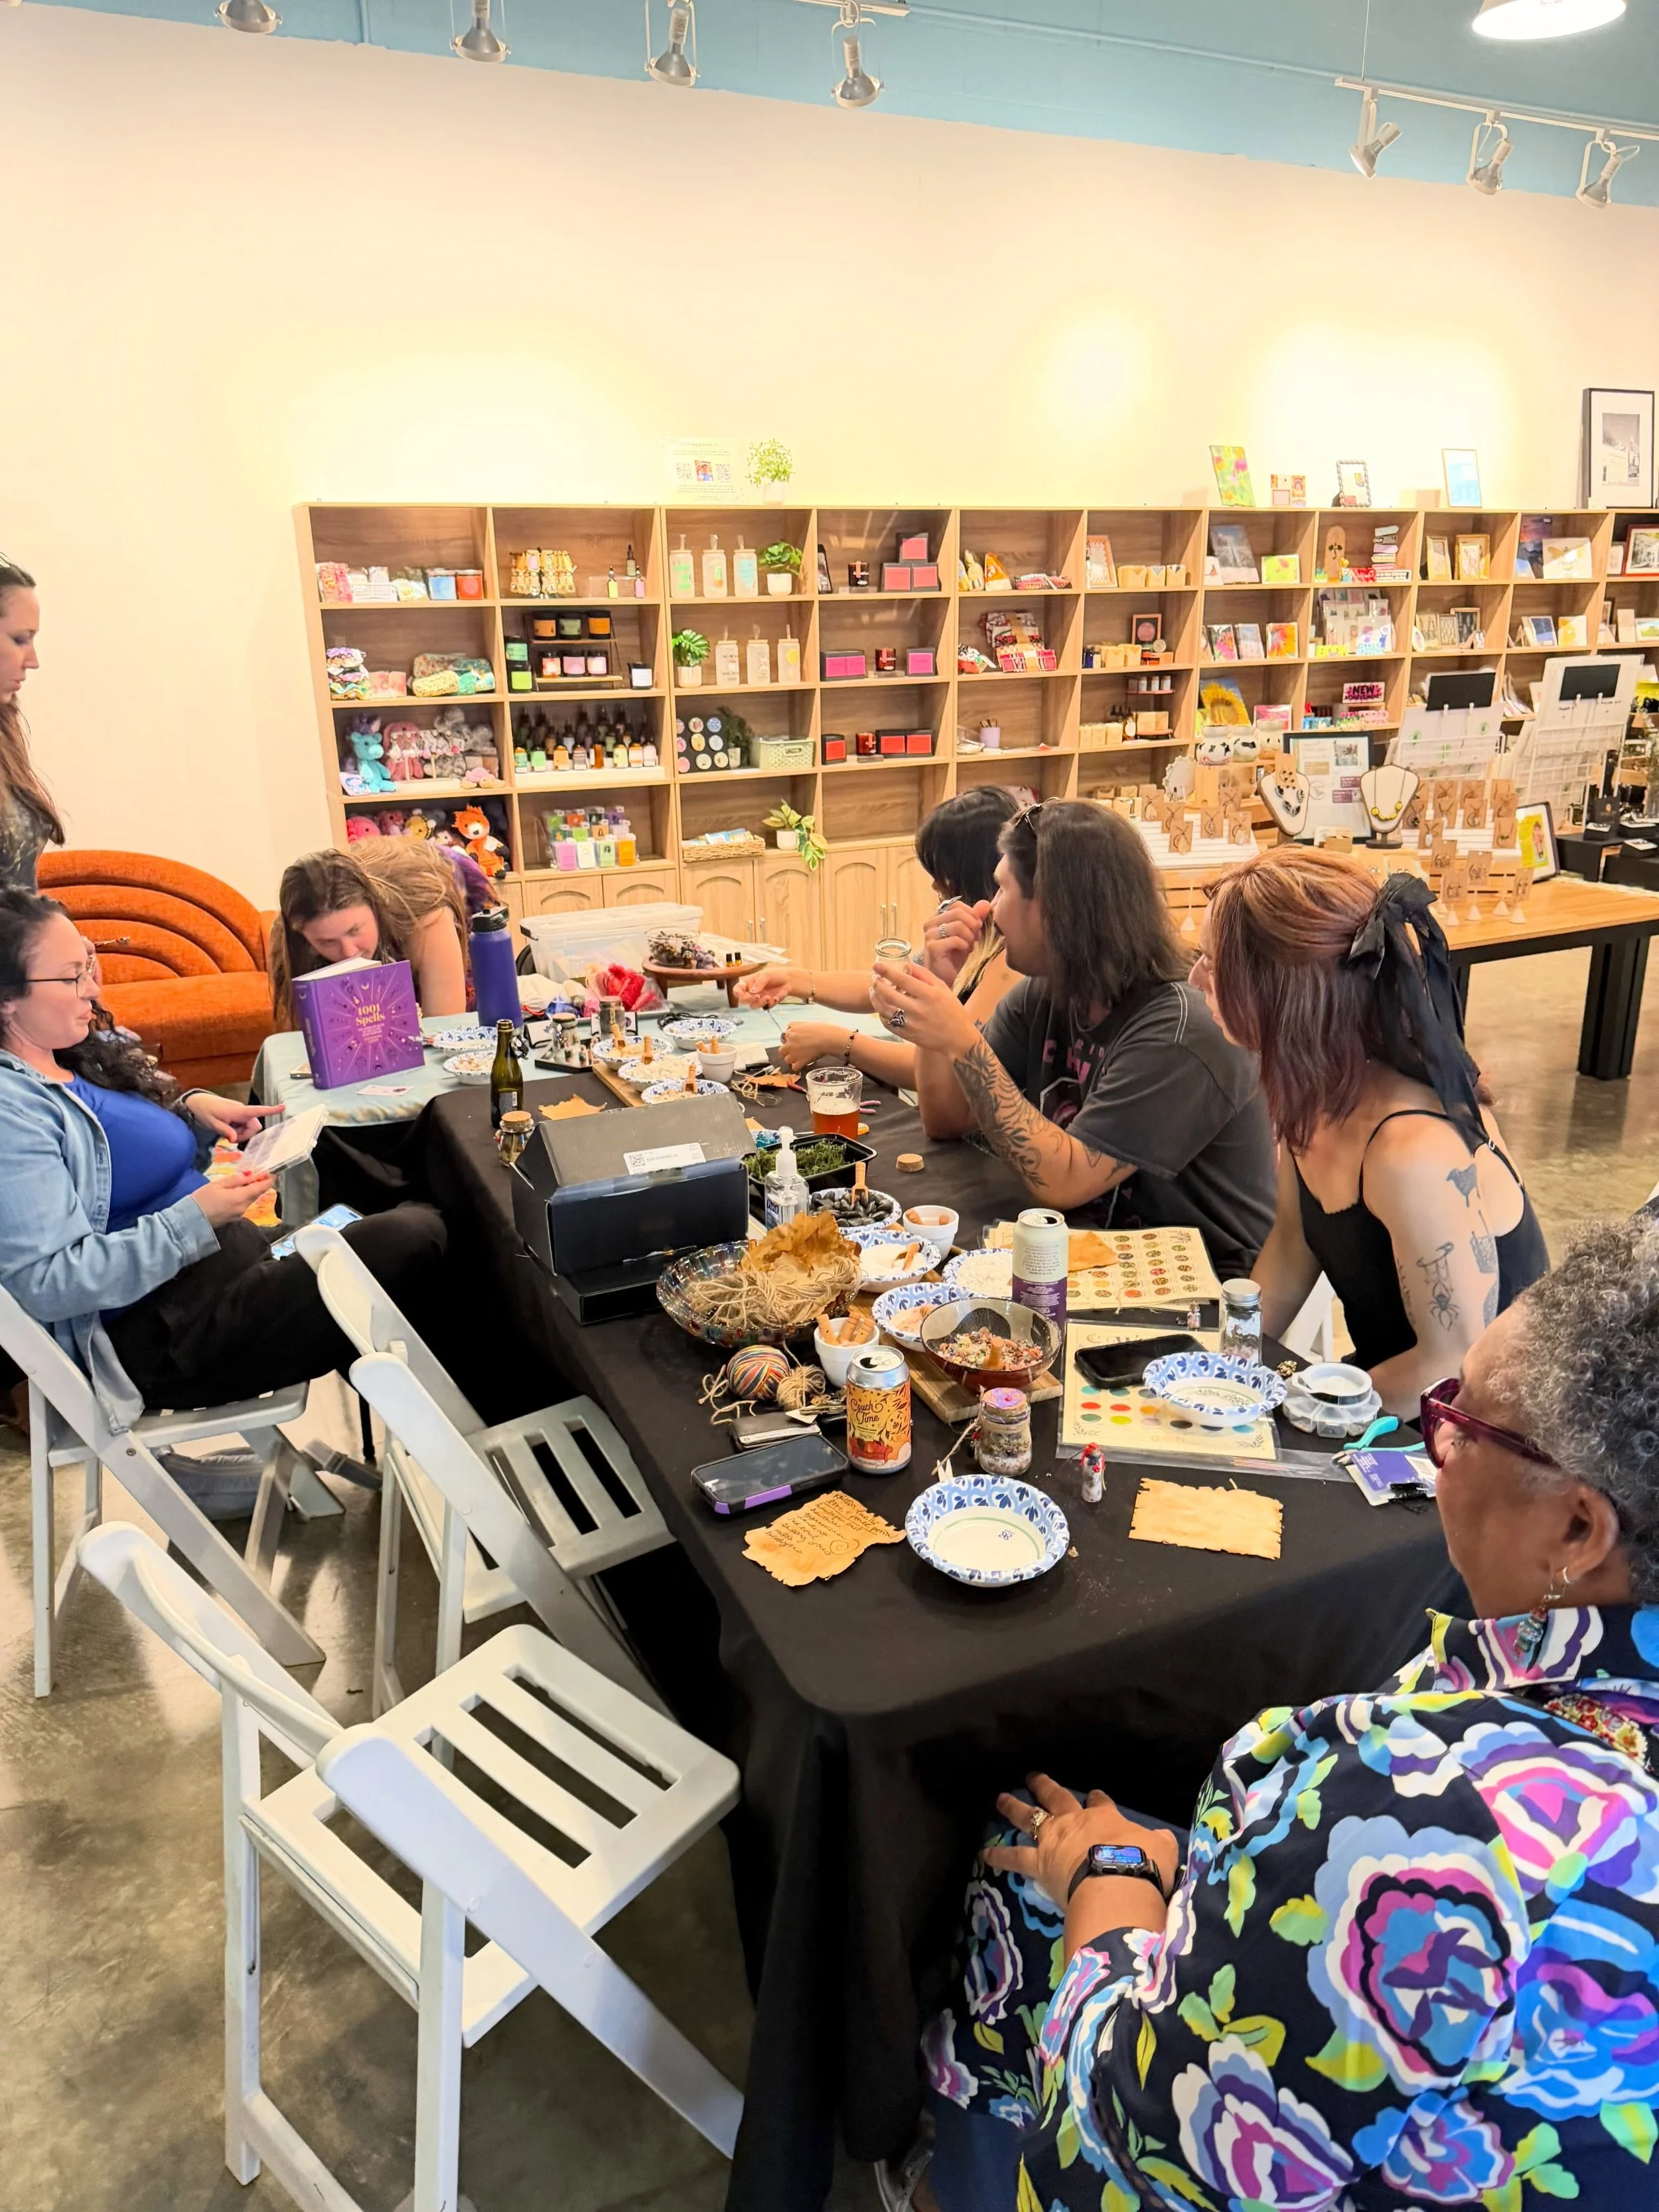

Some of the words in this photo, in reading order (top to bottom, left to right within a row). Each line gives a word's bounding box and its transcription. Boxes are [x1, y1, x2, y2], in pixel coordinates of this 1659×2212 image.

[1352, 685, 1374, 694] NEW
[358, 1003, 380, 1015] 1001
[356, 1012, 386, 1027] Spells
[851, 1398, 883, 1413] Couch
[856, 1411, 879, 1424] Time
